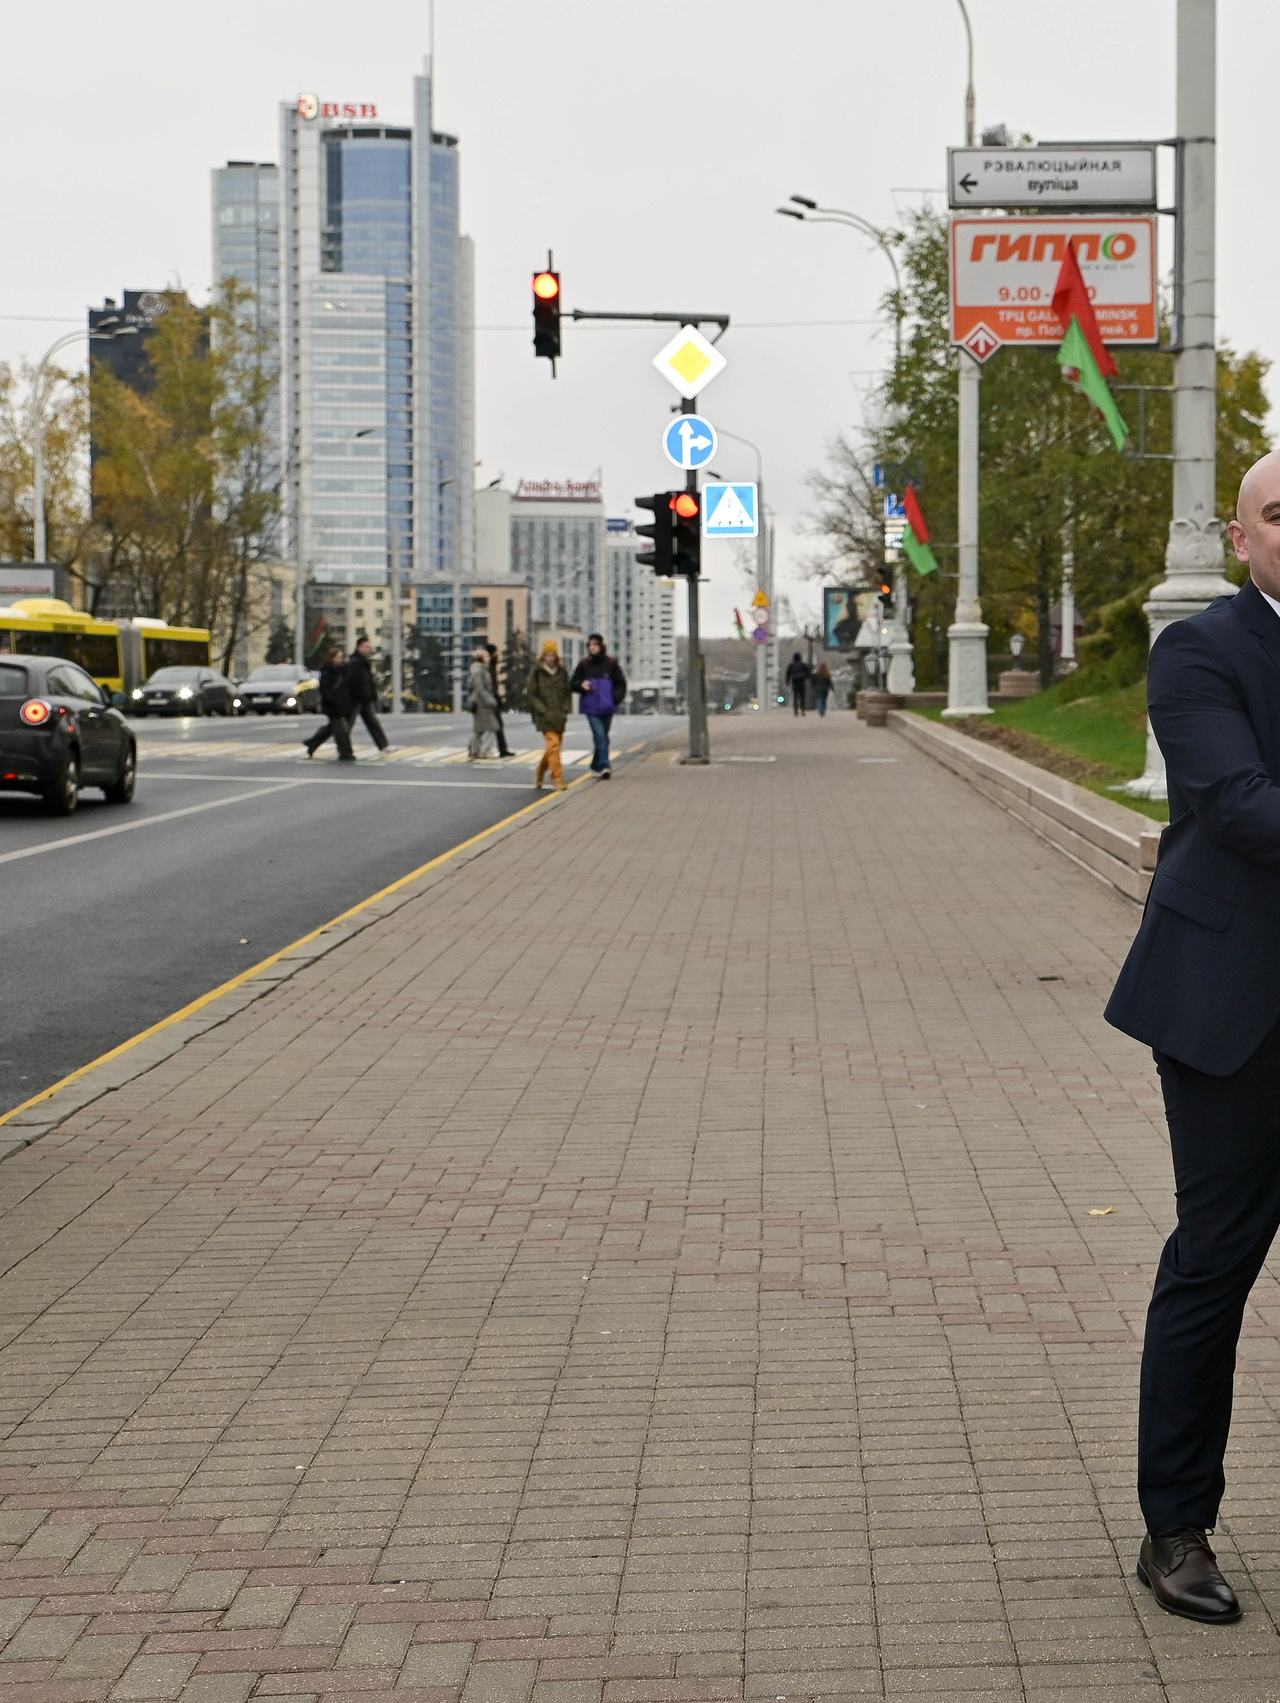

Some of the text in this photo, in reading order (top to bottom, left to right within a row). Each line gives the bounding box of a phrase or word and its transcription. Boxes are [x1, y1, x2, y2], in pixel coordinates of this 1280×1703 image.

[321, 103, 378, 118] BSB
[983, 157, 1122, 173] РЭВАЛЮЦЫЙНАЯ
[1027, 175, 1079, 194] вуліца
[998, 310, 1025, 323] ТРЦ
